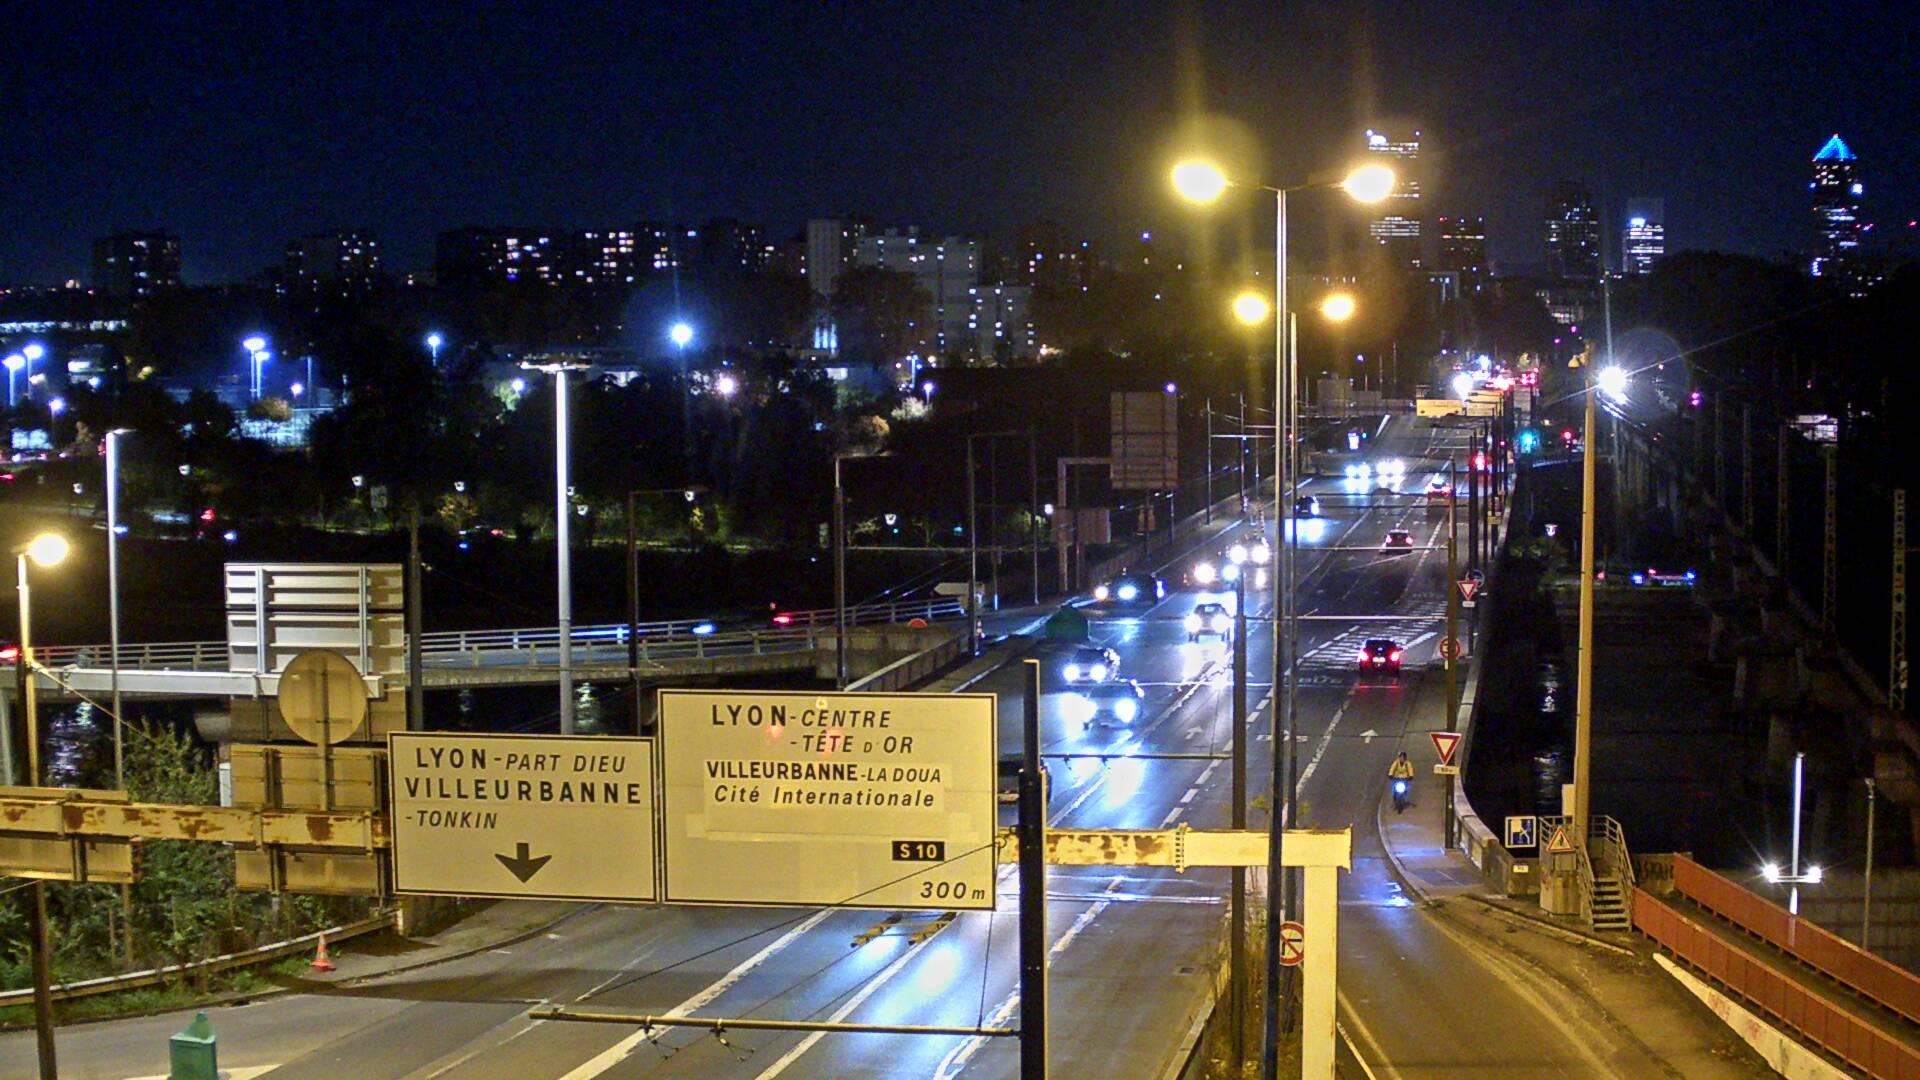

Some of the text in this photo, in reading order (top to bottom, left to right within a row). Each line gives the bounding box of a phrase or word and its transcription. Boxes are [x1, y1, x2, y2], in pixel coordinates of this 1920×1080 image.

[574, 755, 625, 773] DIEU
[892, 769, 941, 783] DOUA
[405, 777, 641, 804] VILLEURBANNE
[714, 784, 934, 807] Cité Internationale
